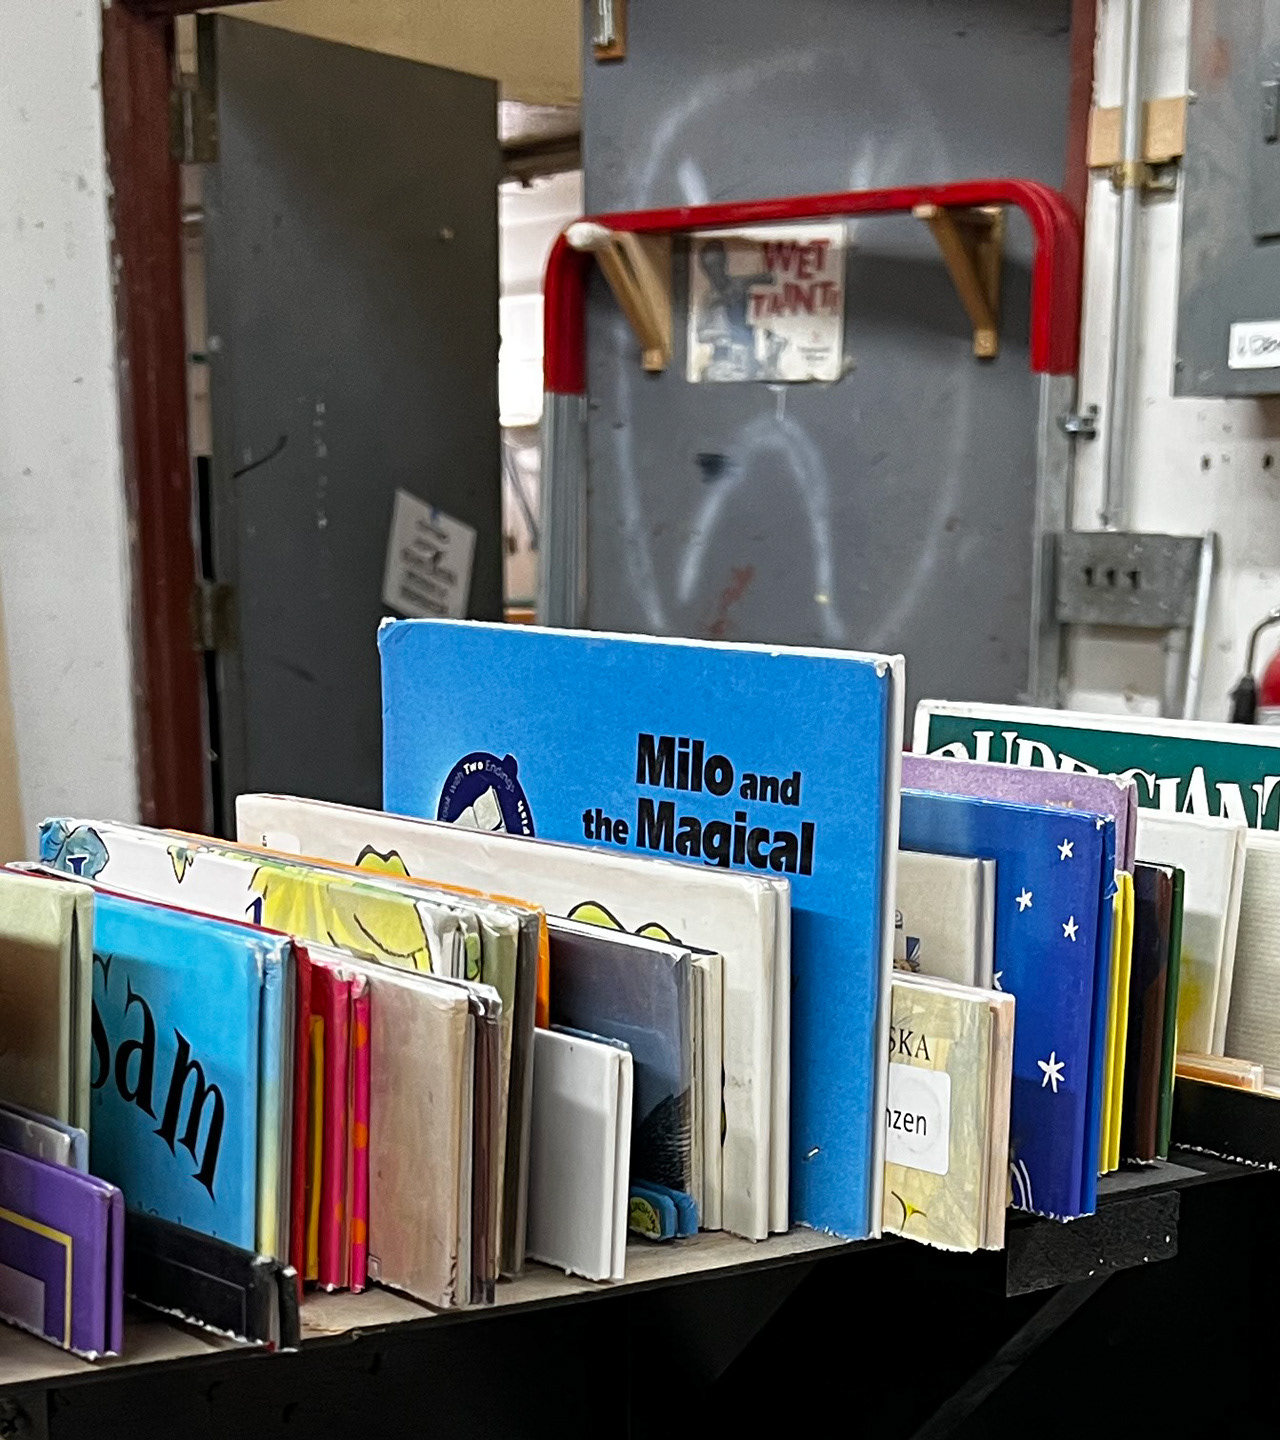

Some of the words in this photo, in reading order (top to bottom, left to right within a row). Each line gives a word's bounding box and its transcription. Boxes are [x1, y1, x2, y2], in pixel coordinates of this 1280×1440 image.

[763, 238, 829, 280] WET
[463, 761, 484, 775] Two
[636, 733, 734, 796] Milo
[740, 771, 801, 806] and
[582, 808, 629, 845] the
[636, 797, 815, 876] Magical
[890, 1027, 930, 1061] SKA
[886, 1107, 927, 1136] nzen
